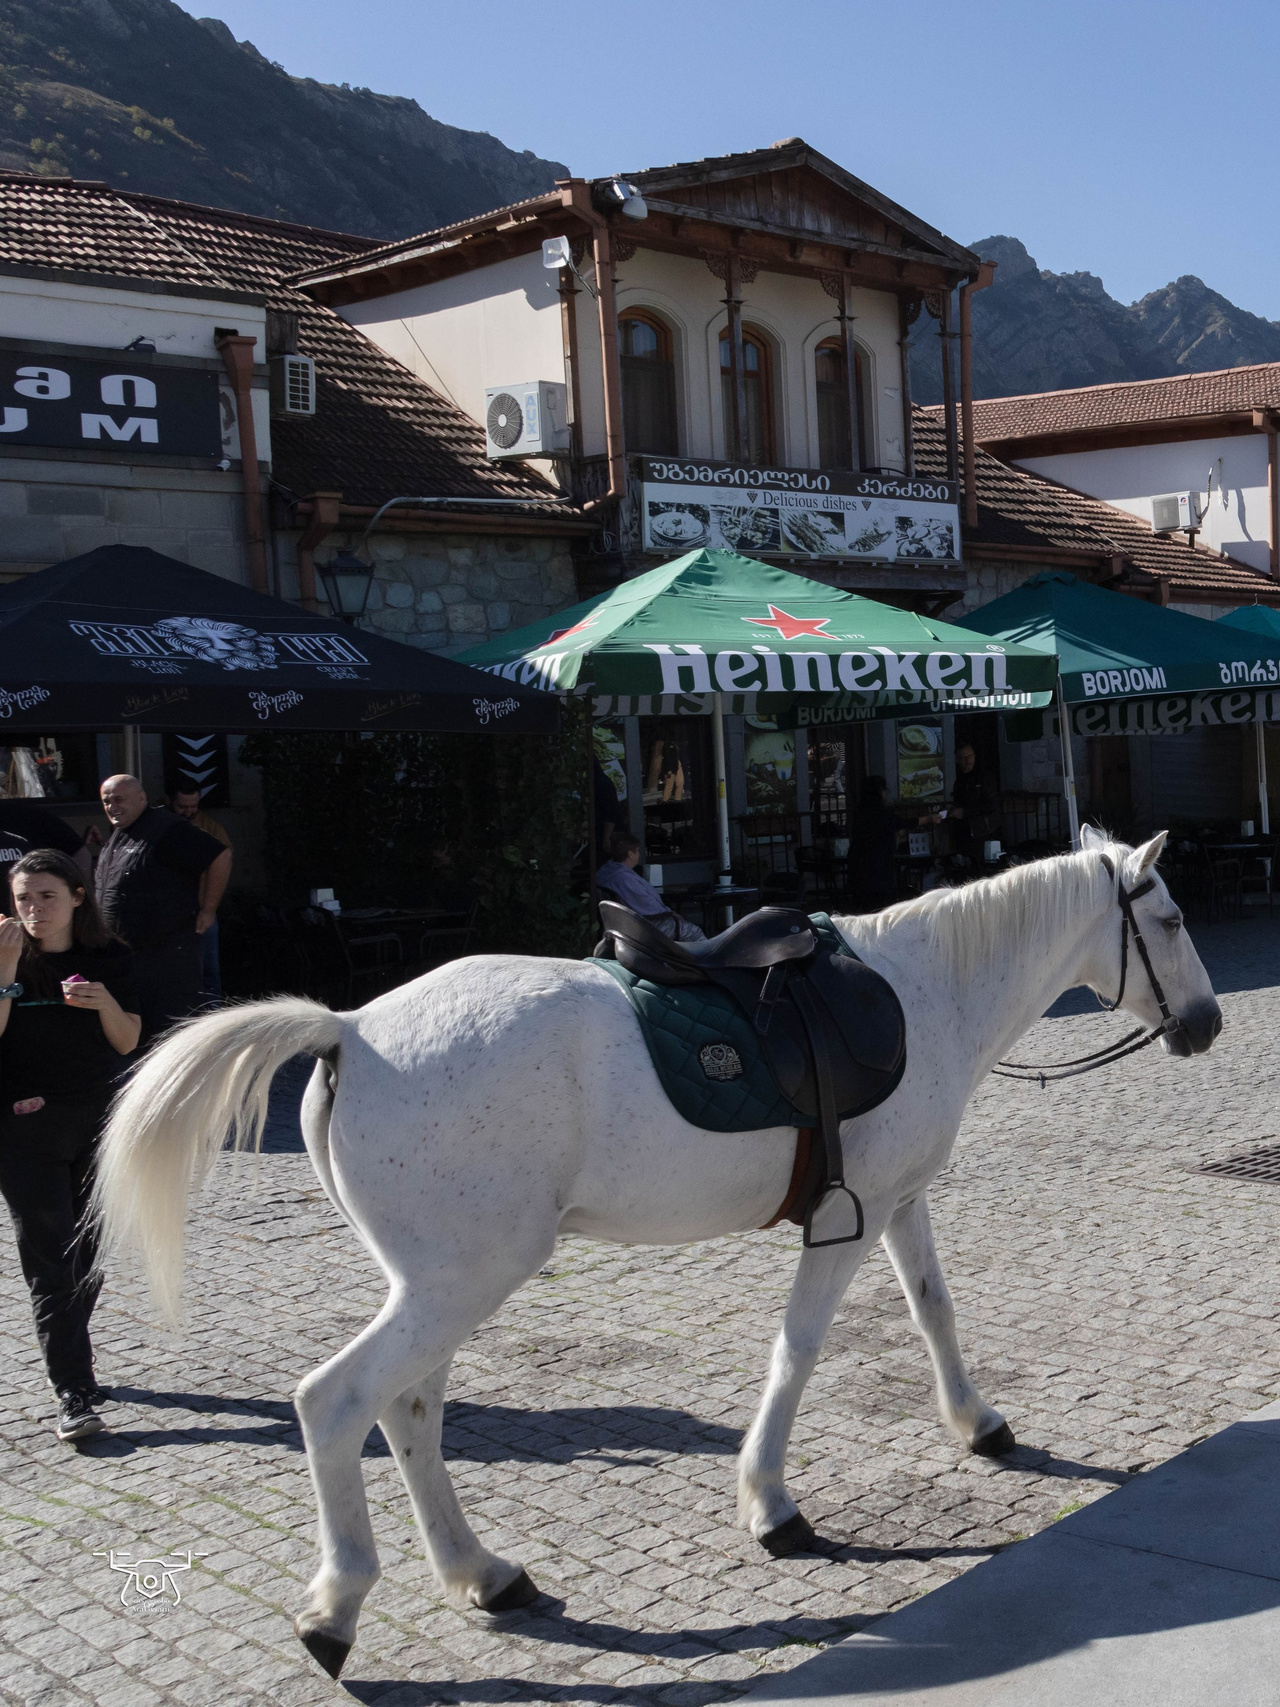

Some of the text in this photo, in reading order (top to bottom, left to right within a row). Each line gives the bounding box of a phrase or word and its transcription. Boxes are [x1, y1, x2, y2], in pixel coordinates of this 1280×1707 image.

[526, 395, 537, 435] AUX
[649, 462, 949, 500] უგემრიელესი კერძები
[762, 491, 857, 511] Delicious dishes
[643, 644, 1013, 694] Heineken
[1082, 667, 1167, 696] BORJOMI
